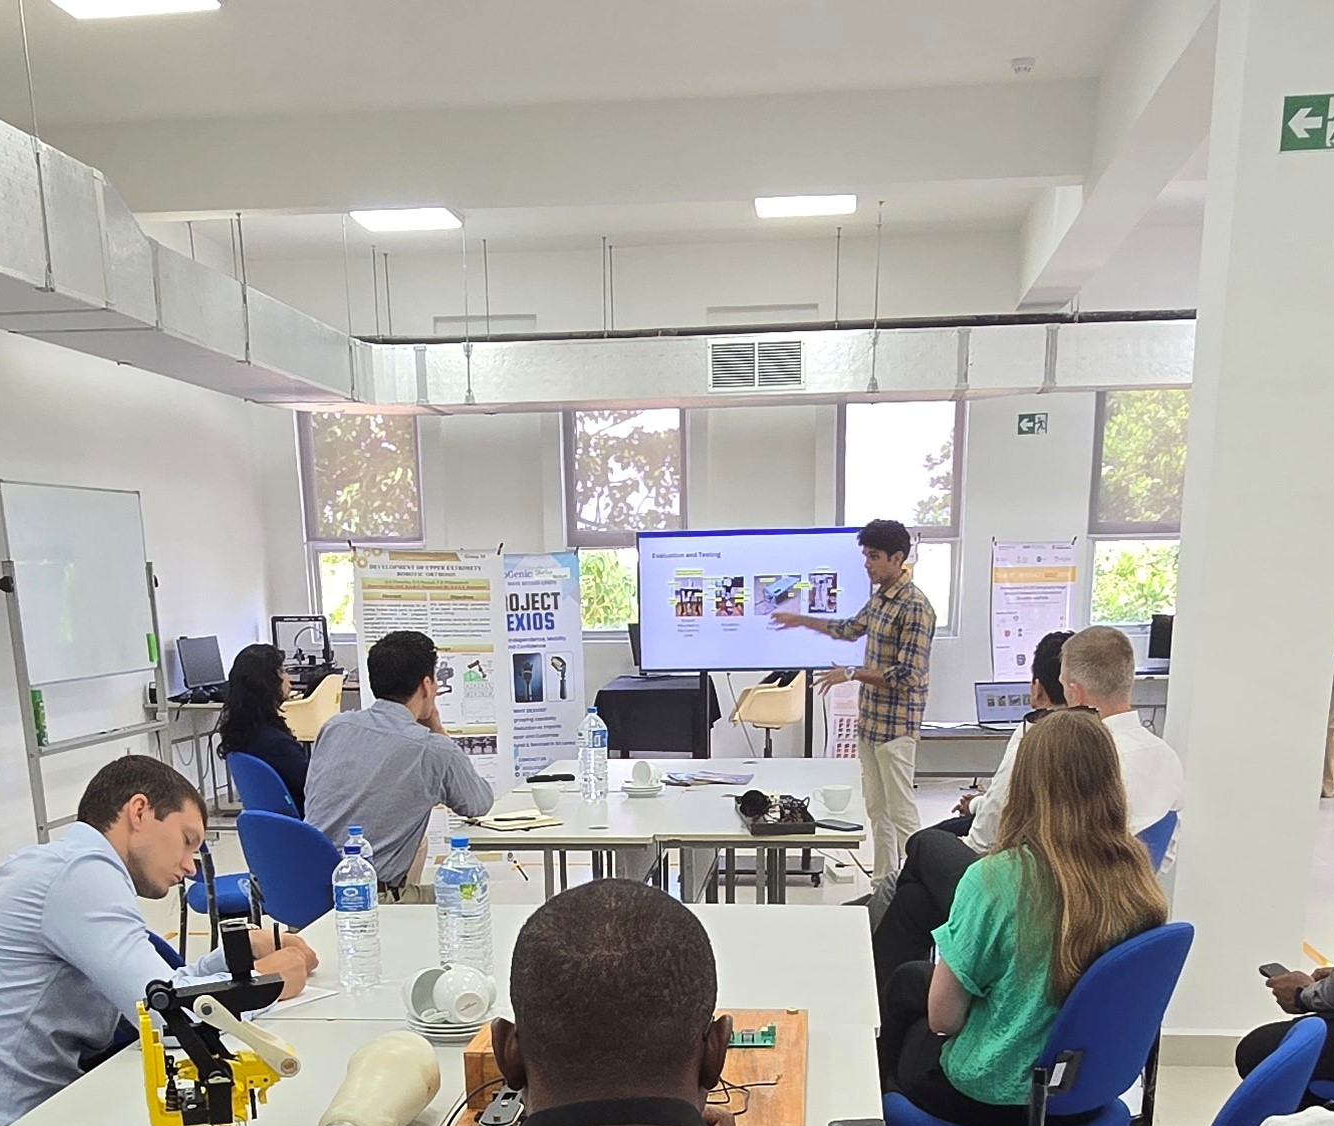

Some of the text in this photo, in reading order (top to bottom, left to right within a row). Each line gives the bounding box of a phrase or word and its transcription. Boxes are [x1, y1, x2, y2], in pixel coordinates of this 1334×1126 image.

[698, 551, 721, 559] Testing
[506, 591, 561, 612] OJECT
[507, 611, 555, 632] EXIOS
